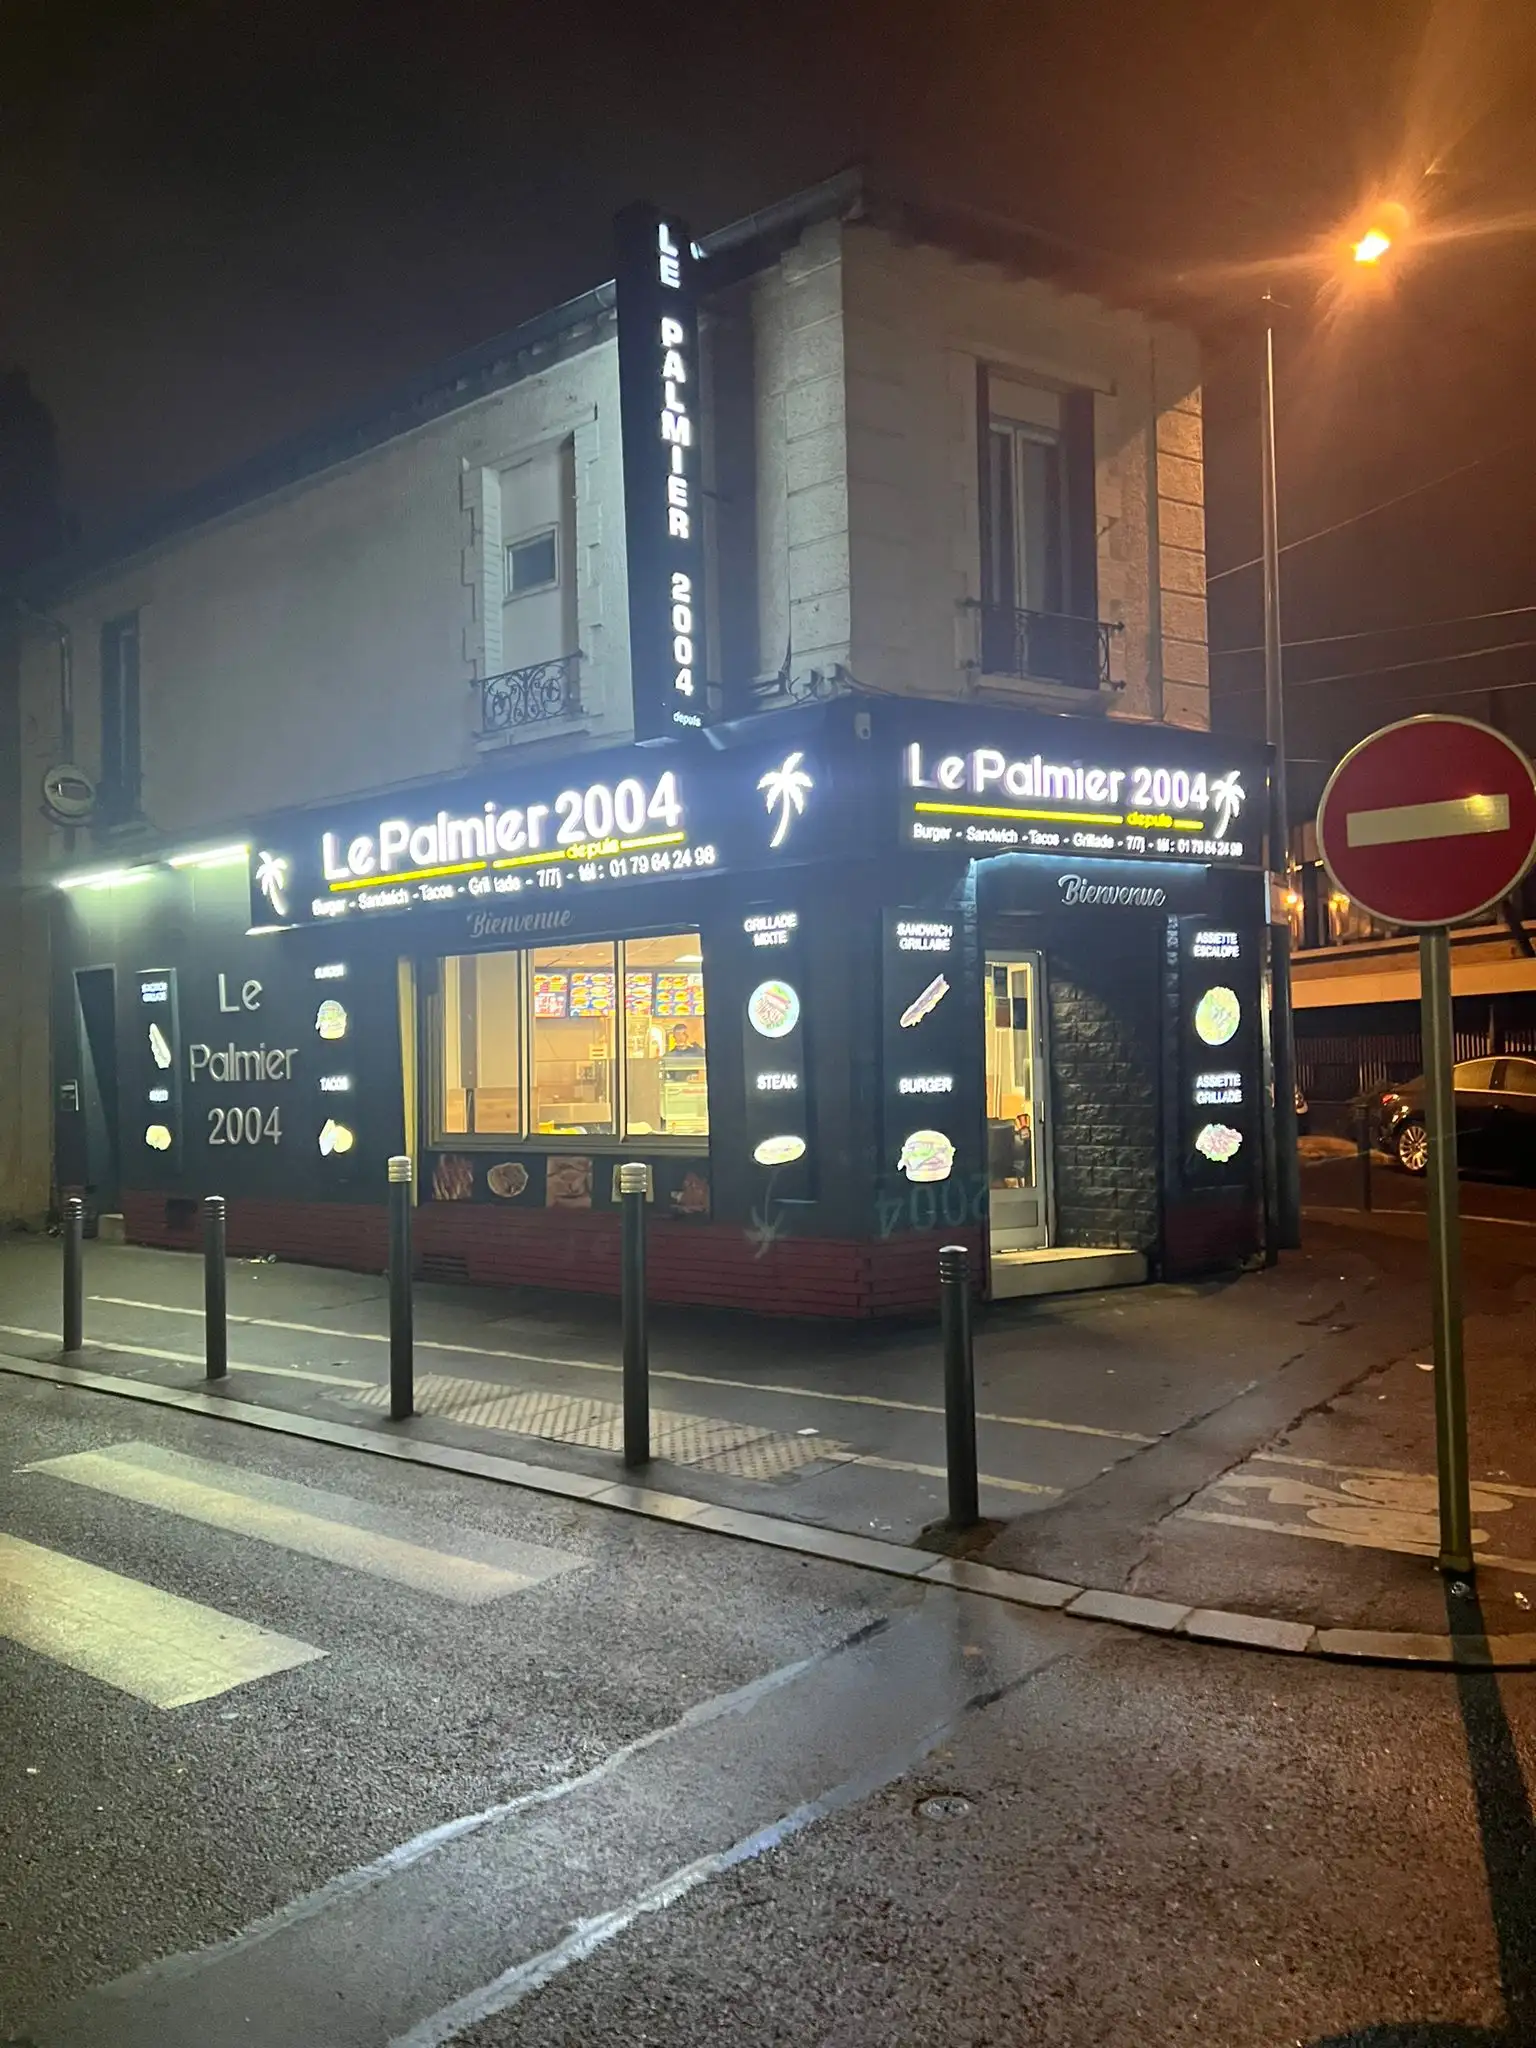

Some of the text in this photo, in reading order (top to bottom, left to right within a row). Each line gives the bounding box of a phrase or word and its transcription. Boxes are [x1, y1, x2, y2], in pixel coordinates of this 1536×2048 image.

[658, 223, 695, 697] LE PALMIER 2004
[673, 711, 701, 727] depuis
[909, 742, 1209, 811] Le Palmier 2004
[322, 771, 682, 881] Le Palmier 2004
[913, 822, 952, 842] Burger
[966, 825, 1018, 843] Sandwich
[1028, 829, 1060, 846] Tacos
[1072, 832, 1115, 849] Grillade
[565, 838, 621, 860] depuis
[358, 888, 410, 910] Sandwich
[418, 883, 453, 902] Tacos
[1058, 874, 1166, 907] Bienvenue
[467, 909, 572, 938] Bienvenue
[744, 912, 798, 932] GRILLADE
[897, 922, 953, 938] SANDWICH
[899, 936, 951, 952] GRILLADE
[218, 973, 263, 1013] Le
[189, 1042, 299, 1083] Palmier
[757, 1073, 798, 1091] STEAK
[900, 1076, 953, 1094] BURGER
[208, 1106, 283, 1145] 2004
